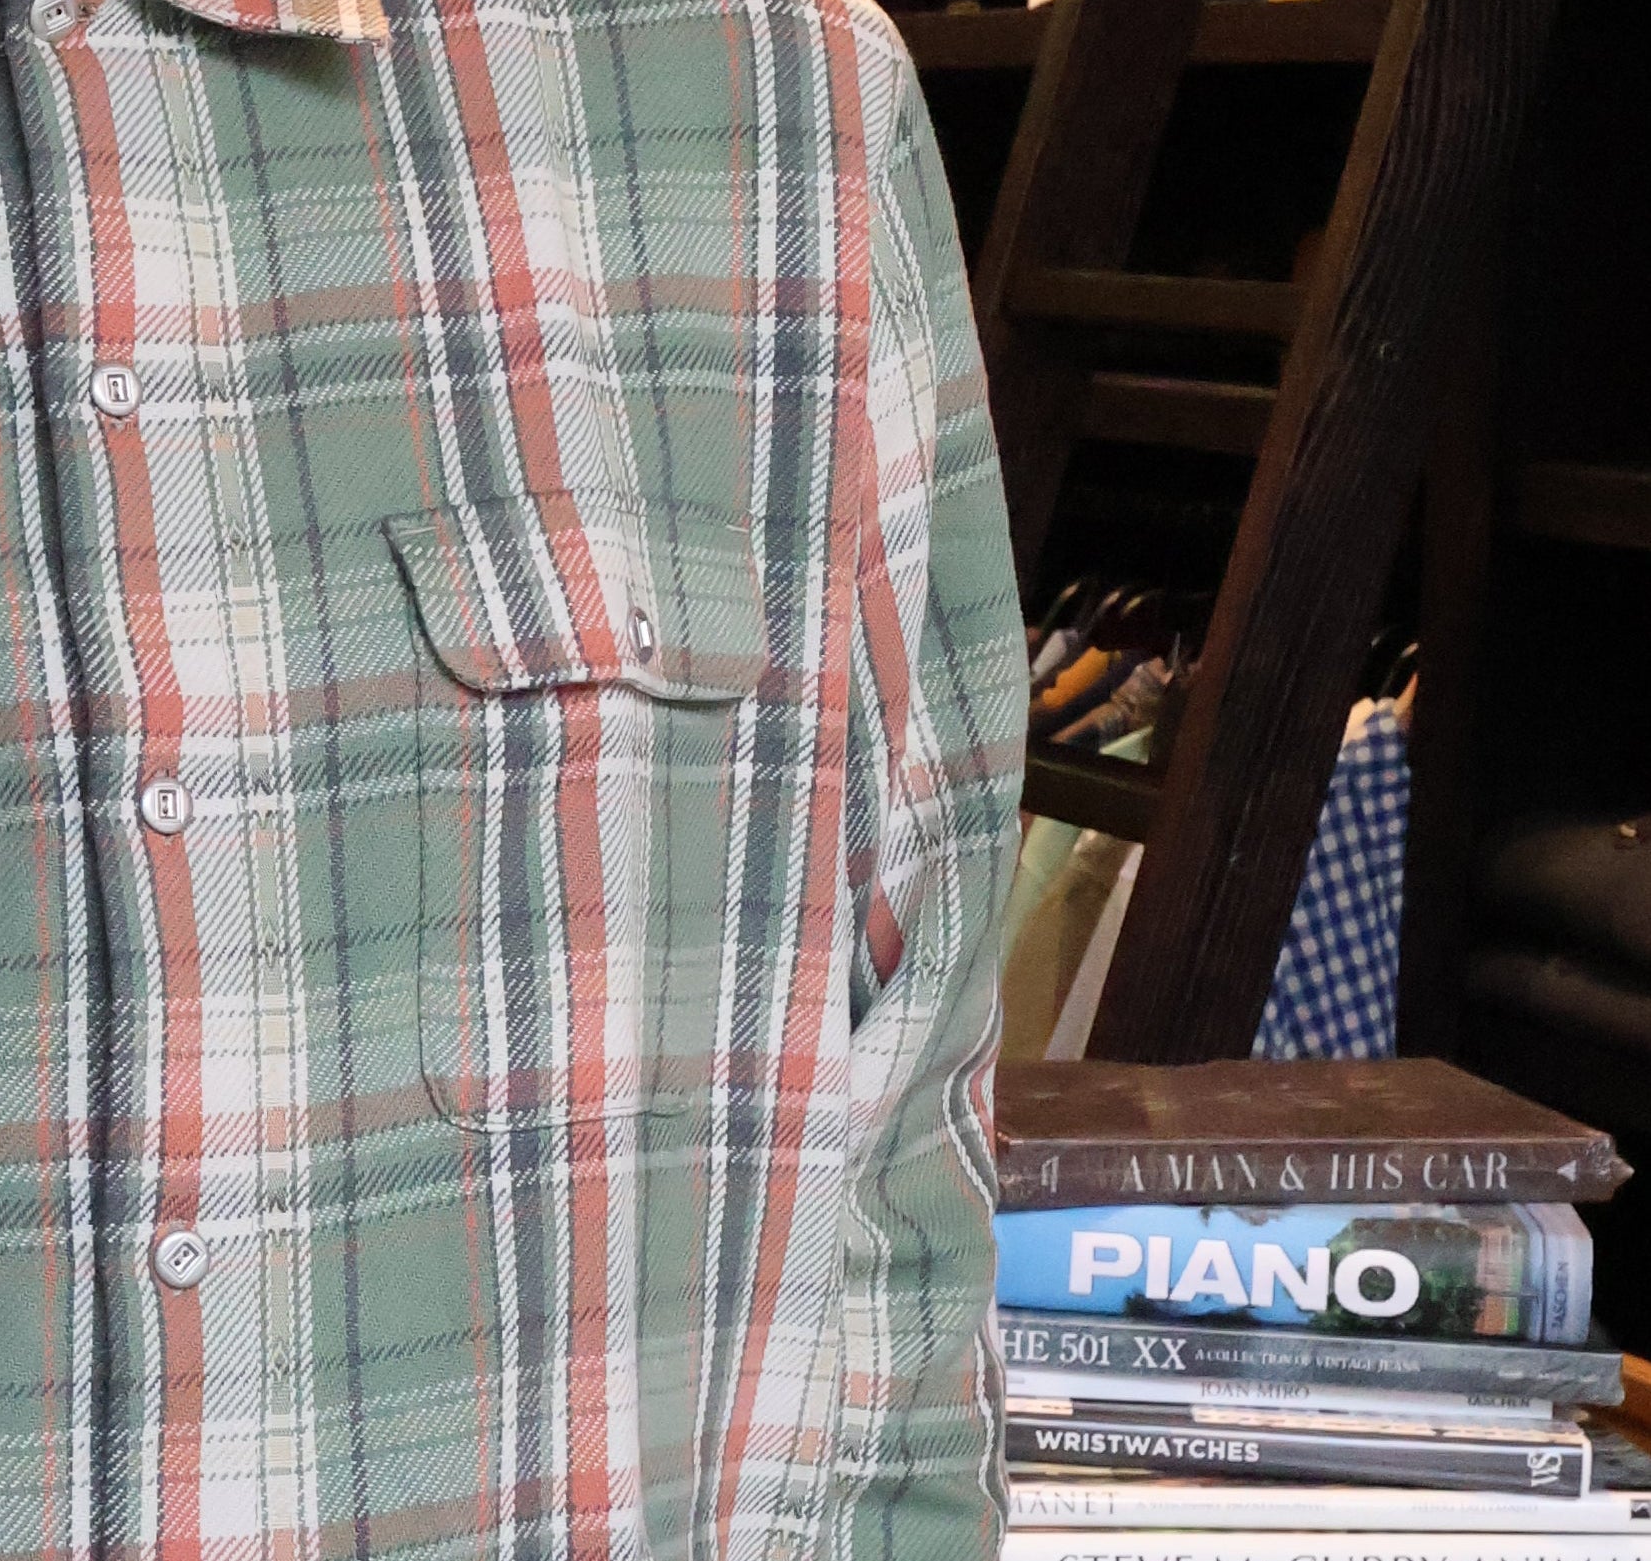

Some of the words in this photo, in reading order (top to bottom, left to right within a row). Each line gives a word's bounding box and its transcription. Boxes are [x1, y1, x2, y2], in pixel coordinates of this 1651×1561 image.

[1120, 1154, 1145, 1191] A
[1164, 1153, 1256, 1191] MAN
[1279, 1153, 1305, 1190] &
[1330, 1153, 1404, 1190] HIS
[1422, 1151, 1508, 1190] CAR
[1068, 1230, 1421, 1317] PIANO
[1059, 1332, 1111, 1366] 501
[1133, 1336, 1187, 1371] XX
[1200, 1380, 1249, 1398] JOAN
[1035, 1429, 1260, 1463] WRISTWATCHES
